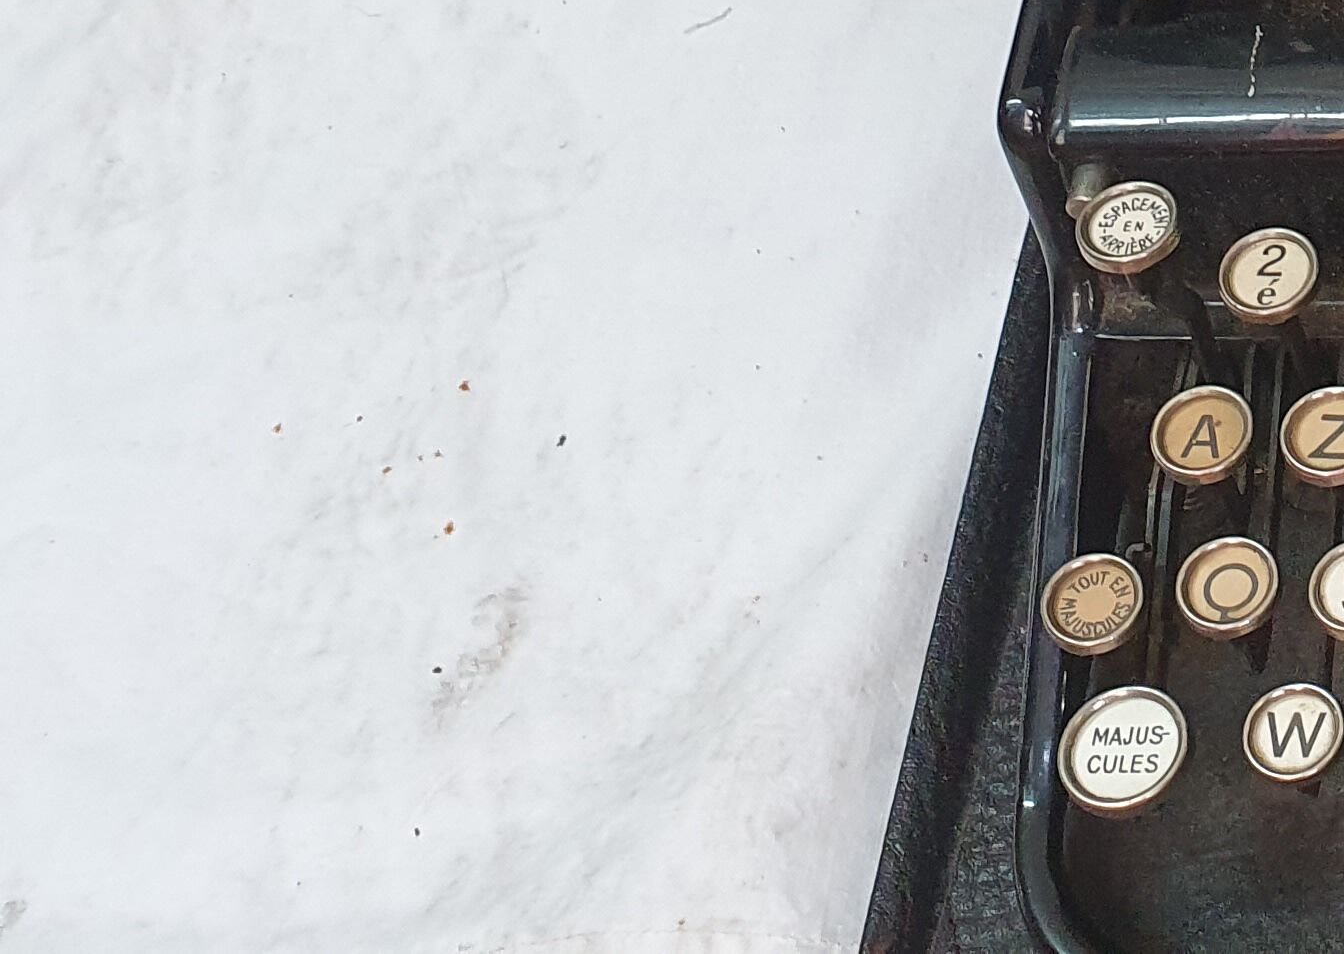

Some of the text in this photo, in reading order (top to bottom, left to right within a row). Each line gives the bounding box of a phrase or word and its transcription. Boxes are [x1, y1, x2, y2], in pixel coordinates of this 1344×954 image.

[1123, 221, 1144, 232] EN
[1257, 245, 1286, 276] 2
[1257, 279, 1279, 305] é
[1181, 415, 1221, 458] A
[1067, 571, 1131, 598] TOUT EN
[1058, 597, 1131, 636] MAJUSCULES
[1092, 726, 1169, 745] MAJUS-
[1267, 712, 1326, 757] W
[1088, 754, 1158, 773] CULES
